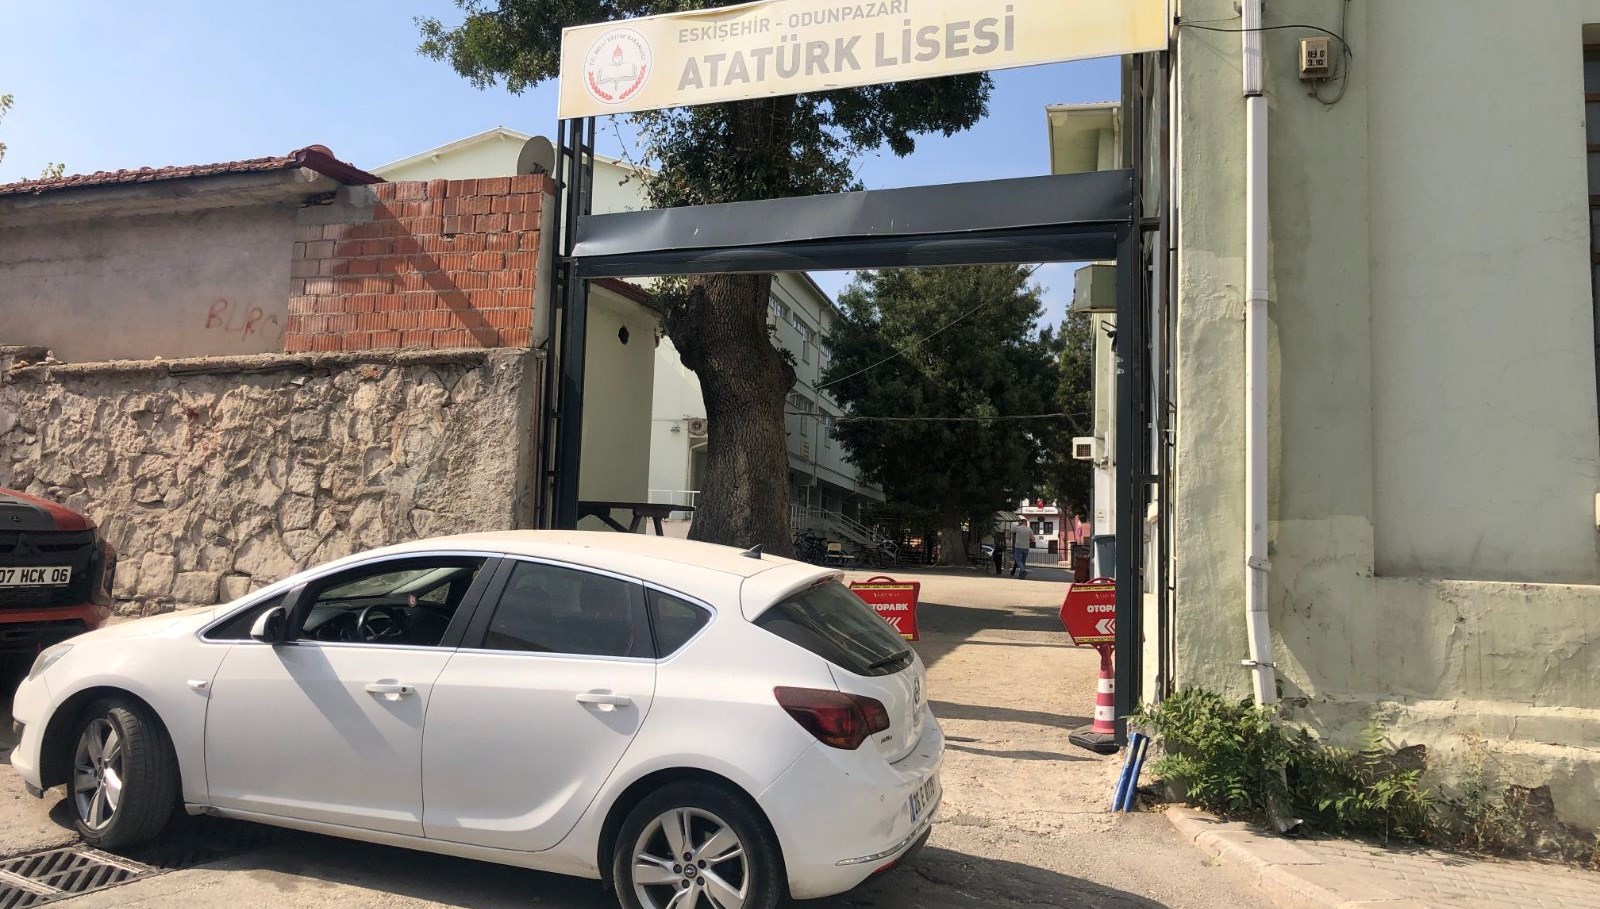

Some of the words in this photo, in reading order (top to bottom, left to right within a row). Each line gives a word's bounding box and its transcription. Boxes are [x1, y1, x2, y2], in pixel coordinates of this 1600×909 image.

[679, 15, 770, 43] ESKİŞEHİR
[788, 0, 909, 28] ODUNPAZARI
[677, 34, 862, 91] ATATÜRK
[875, 4, 1015, 68] LİSESİ
[0, 569, 16, 584] 07
[20, 568, 47, 583] HCK
[51, 568, 69, 583] 06
[870, 603, 909, 612] TOPARK
